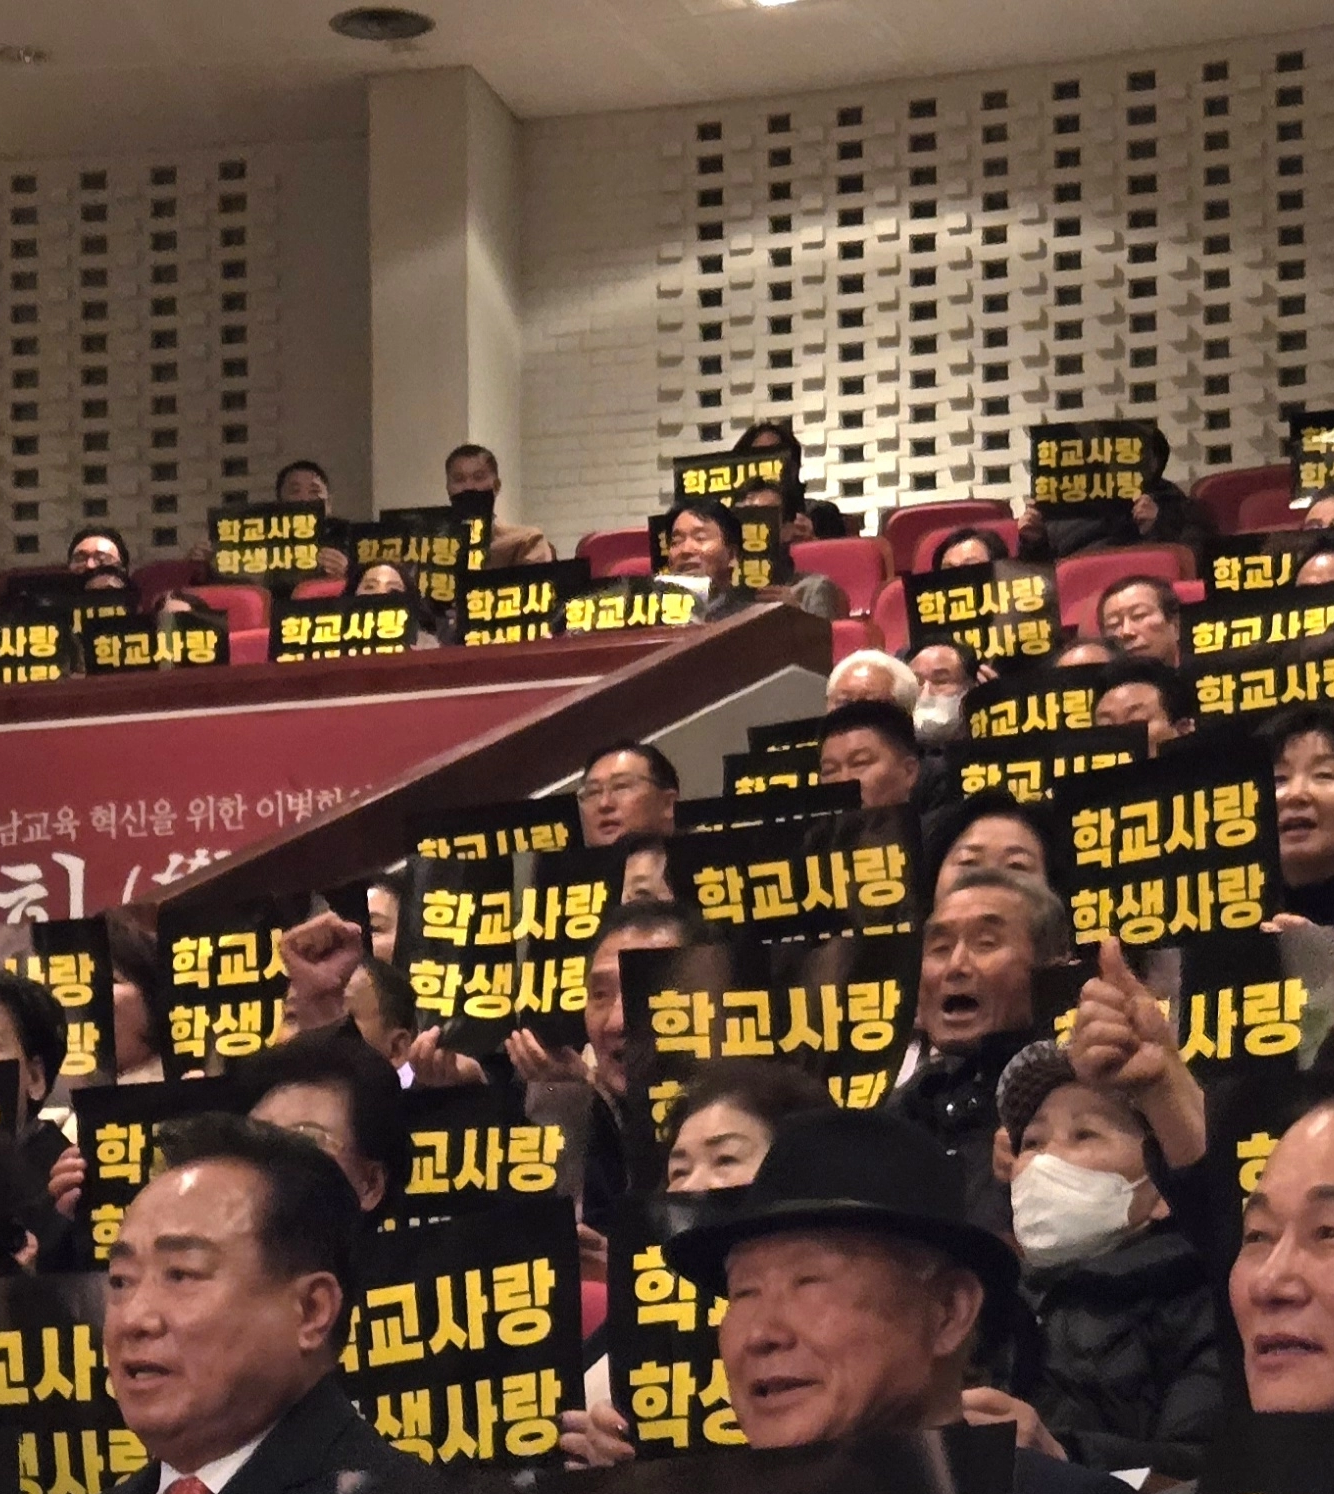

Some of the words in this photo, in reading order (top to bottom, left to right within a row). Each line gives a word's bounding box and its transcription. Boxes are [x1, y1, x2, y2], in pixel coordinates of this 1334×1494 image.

[1037, 438, 1142, 468] 학교사랑
[1035, 472, 1143, 502] 학생사랑
[217, 515, 317, 543] 학교사랑
[1213, 553, 1293, 590] 학교
[467, 583, 553, 620] 학교사
[566, 593, 694, 631] 학교사랑
[917, 575, 1045, 625] 학교사랑
[280, 610, 408, 645] 학교사랑
[94, 631, 218, 667] 학교사랑
[91, 798, 177, 839] 혁신을
[186, 793, 247, 832] 위한
[1071, 781, 1260, 868] 학교사랑
[694, 845, 906, 925] 학교사랑
[1071, 863, 1266, 945] 학생사랑
[422, 882, 608, 947] 학교사랑
[649, 979, 901, 1060] 학교사랑
[405, 1125, 566, 1195] 교사랑
